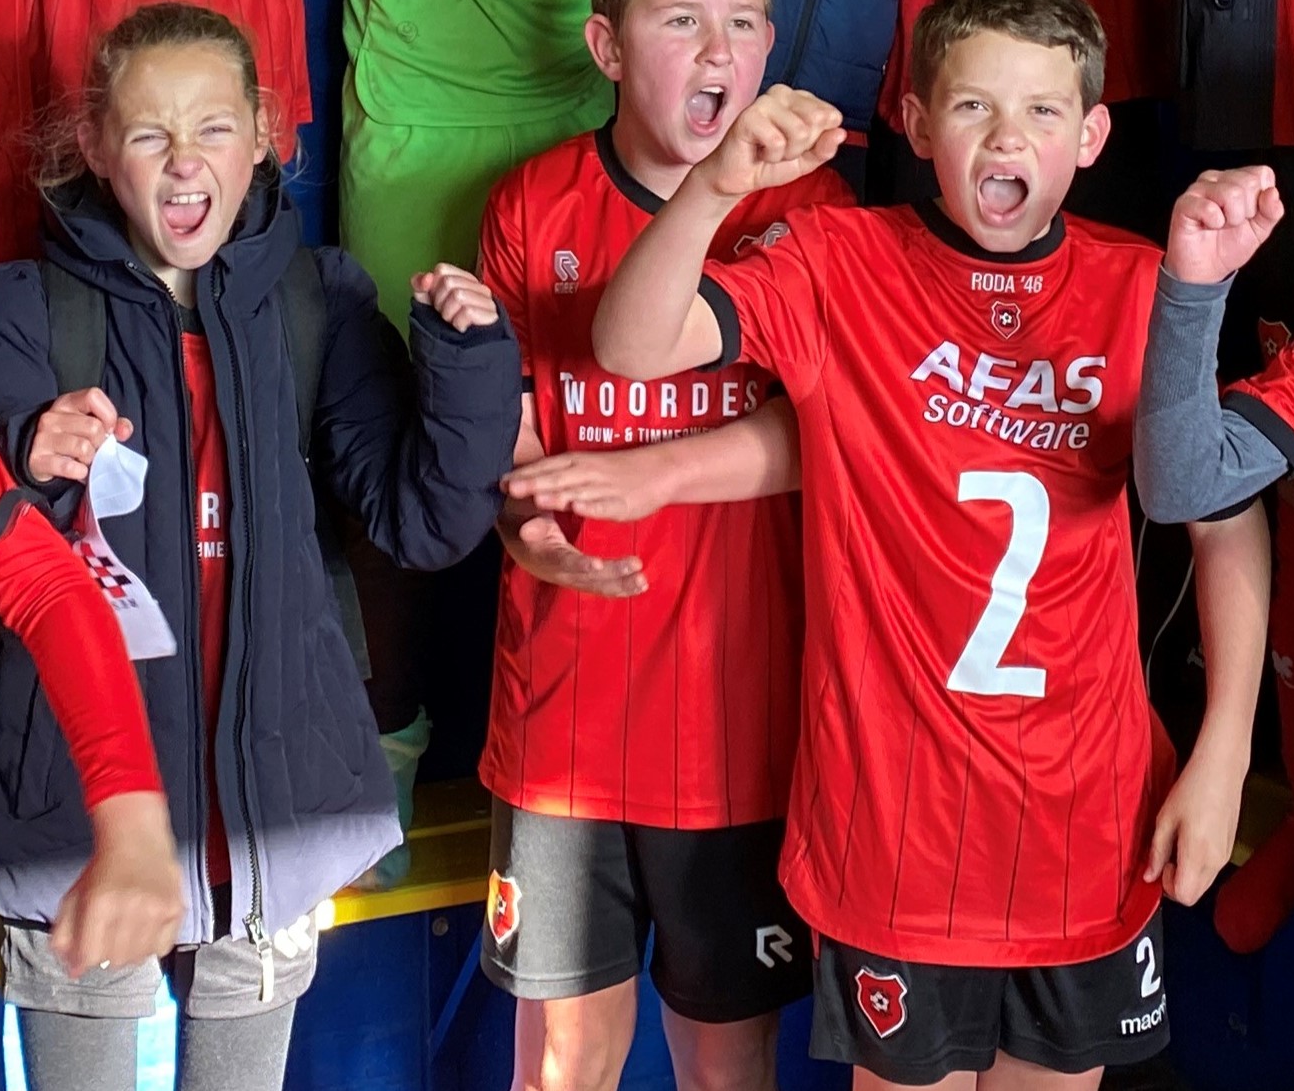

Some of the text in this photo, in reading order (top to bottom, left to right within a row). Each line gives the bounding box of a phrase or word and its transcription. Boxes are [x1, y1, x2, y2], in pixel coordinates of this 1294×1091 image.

[971, 272, 1043, 294] RODA '46
[910, 340, 1106, 415] AFAS
[579, 426, 620, 443] BOUW-
[624, 427, 633, 443] &
[923, 394, 1090, 450] software
[946, 470, 1051, 698] 2
[1135, 936, 1162, 999] 2
